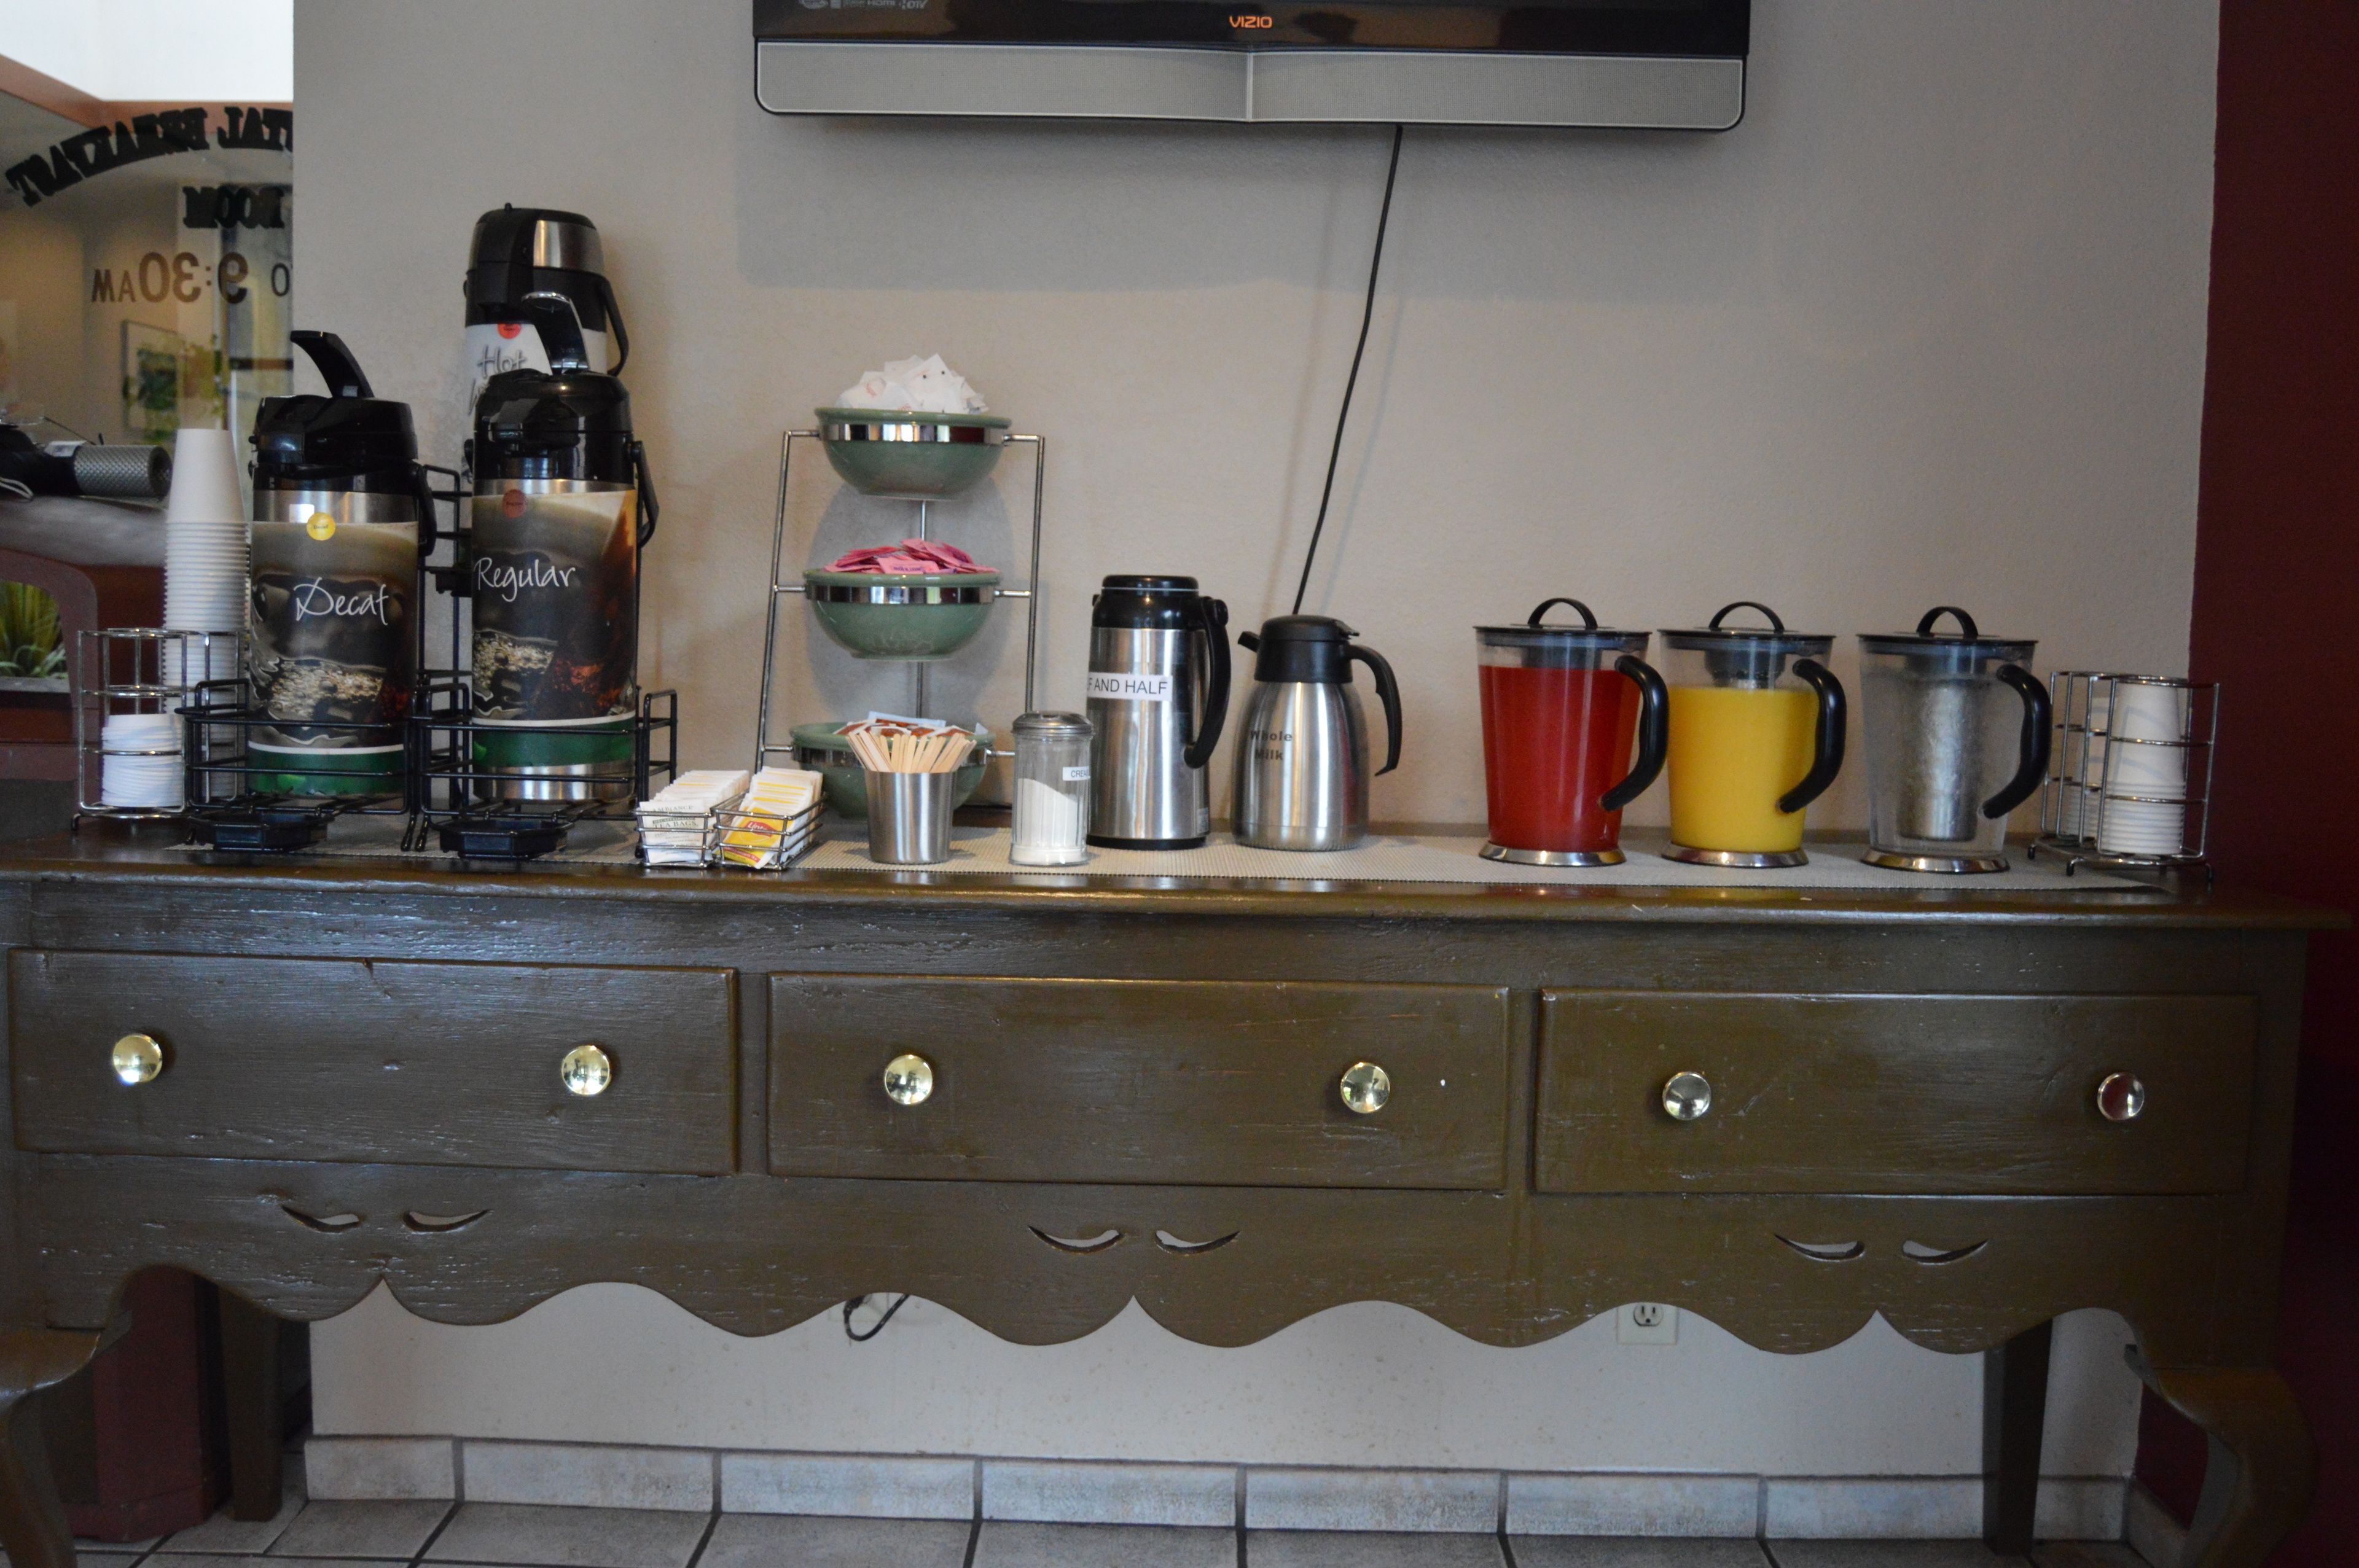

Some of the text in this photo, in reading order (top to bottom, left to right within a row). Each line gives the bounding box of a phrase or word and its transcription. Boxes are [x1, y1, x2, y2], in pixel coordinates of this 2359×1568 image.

[1229, 15, 1272, 28] VIZIO
[477, 343, 527, 380] Hot
[474, 557, 576, 602] Regular
[293, 577, 389, 625] Decaf
[1094, 678, 1119, 692] AND
[1125, 680, 1167, 694] HALF
[1251, 730, 1293, 741] Whole
[1254, 749, 1283, 760] Milk
